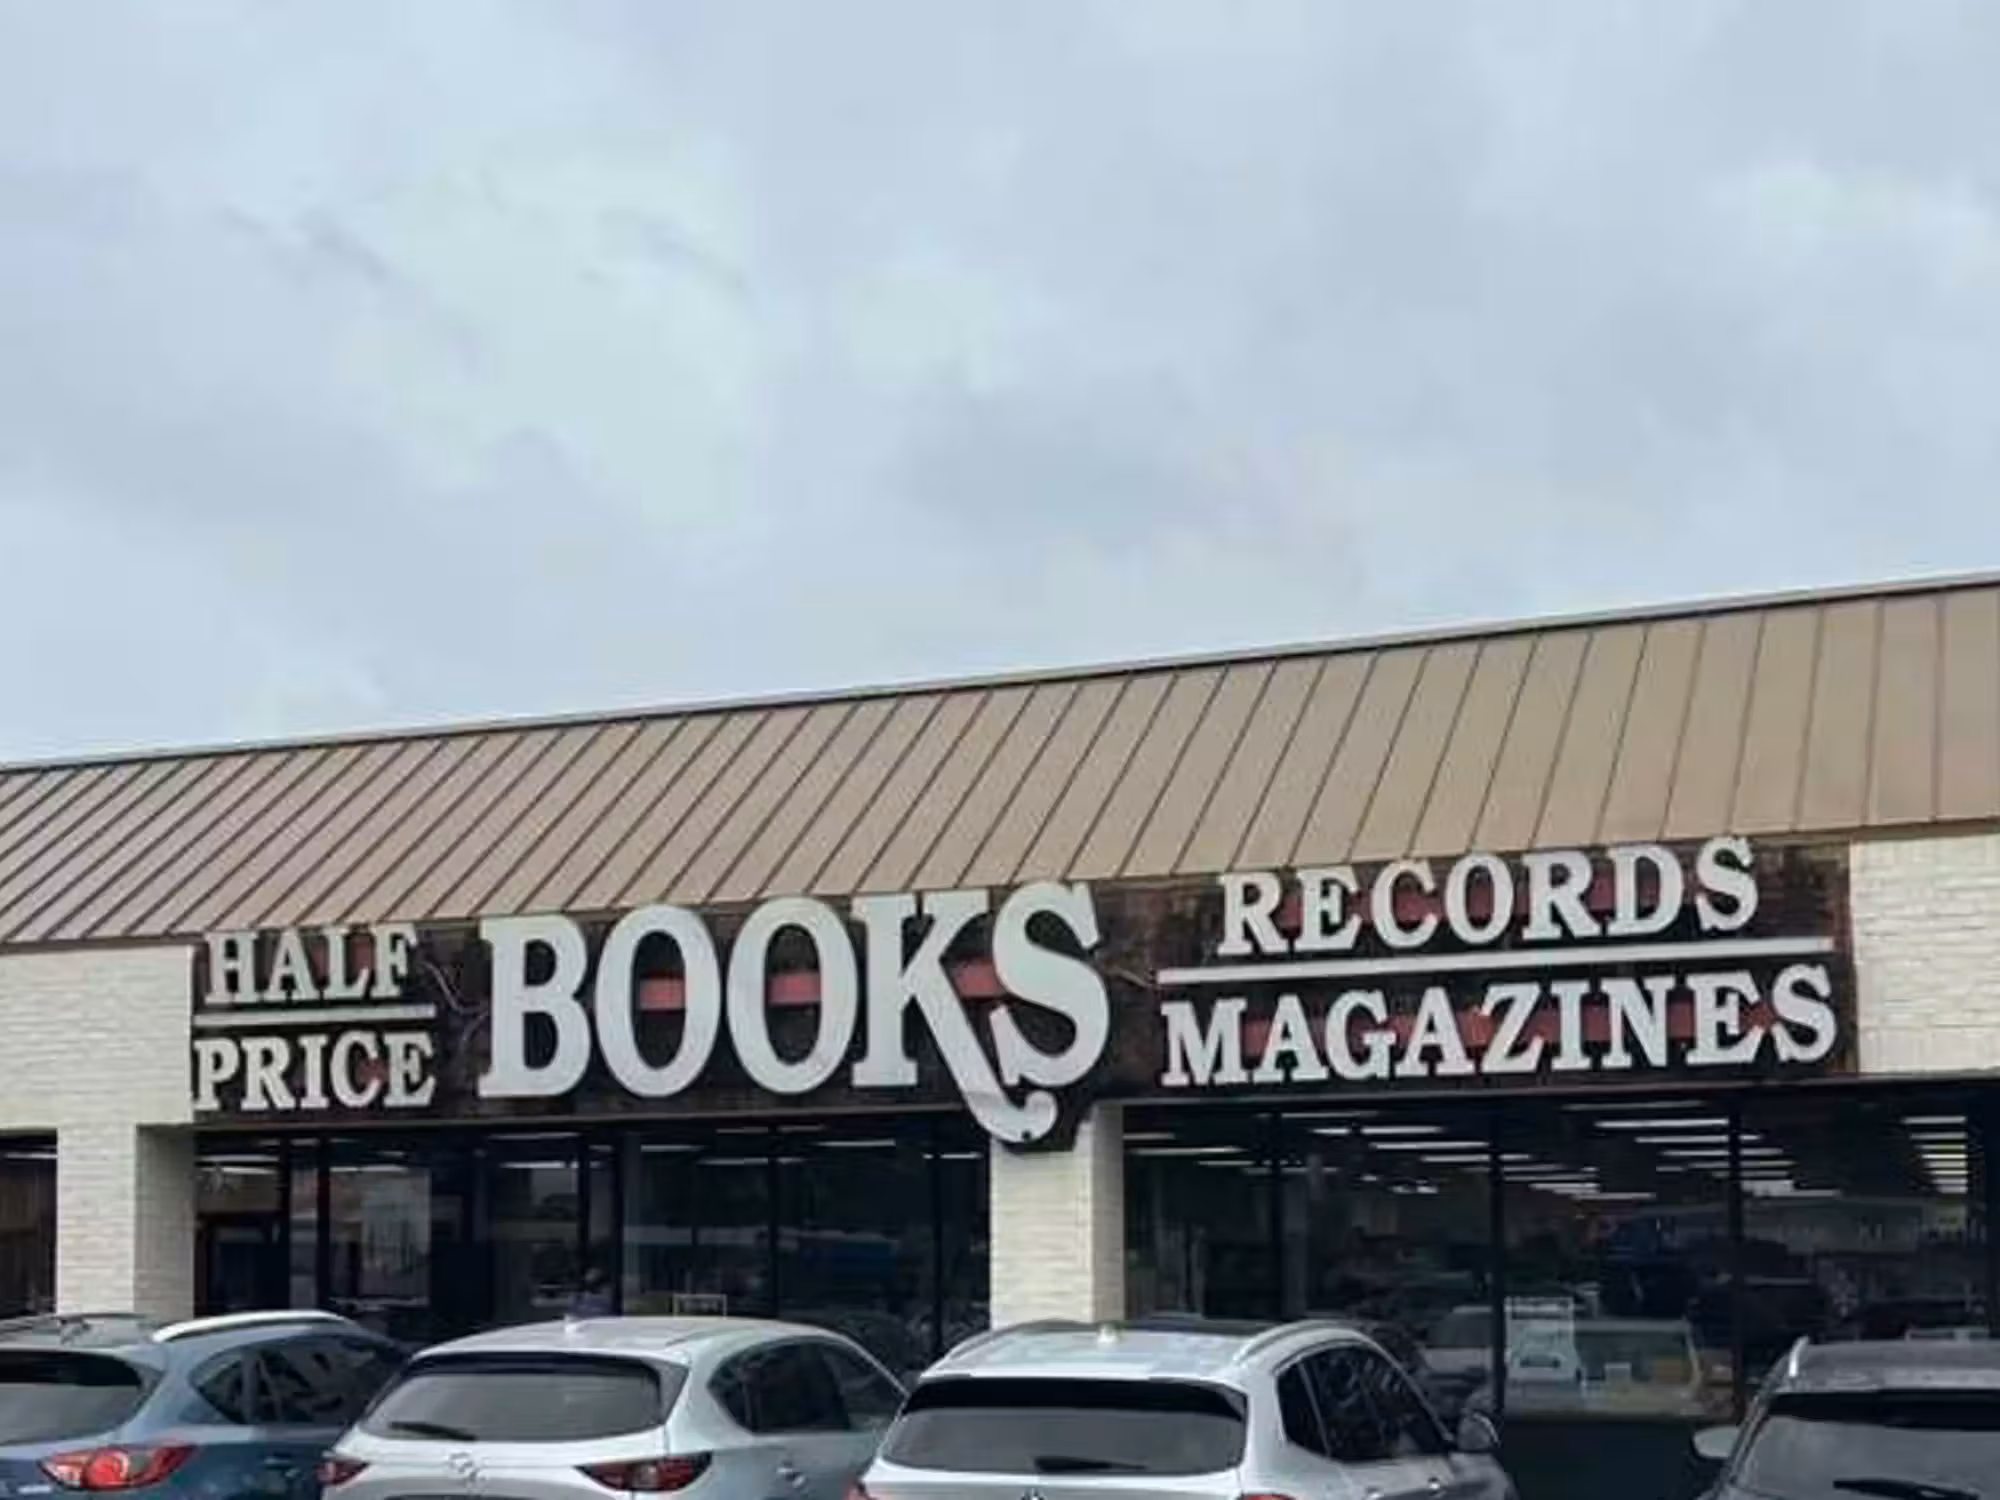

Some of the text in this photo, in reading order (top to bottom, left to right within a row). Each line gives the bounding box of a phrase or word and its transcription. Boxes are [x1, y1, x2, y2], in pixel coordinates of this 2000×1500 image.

[1216, 836, 1759, 957] RECORDS
[204, 922, 418, 1004] HALF
[478, 880, 1110, 1143] BOOKS
[194, 1029, 435, 1111] PRICE
[1160, 963, 1838, 1087] MAGAZINES
